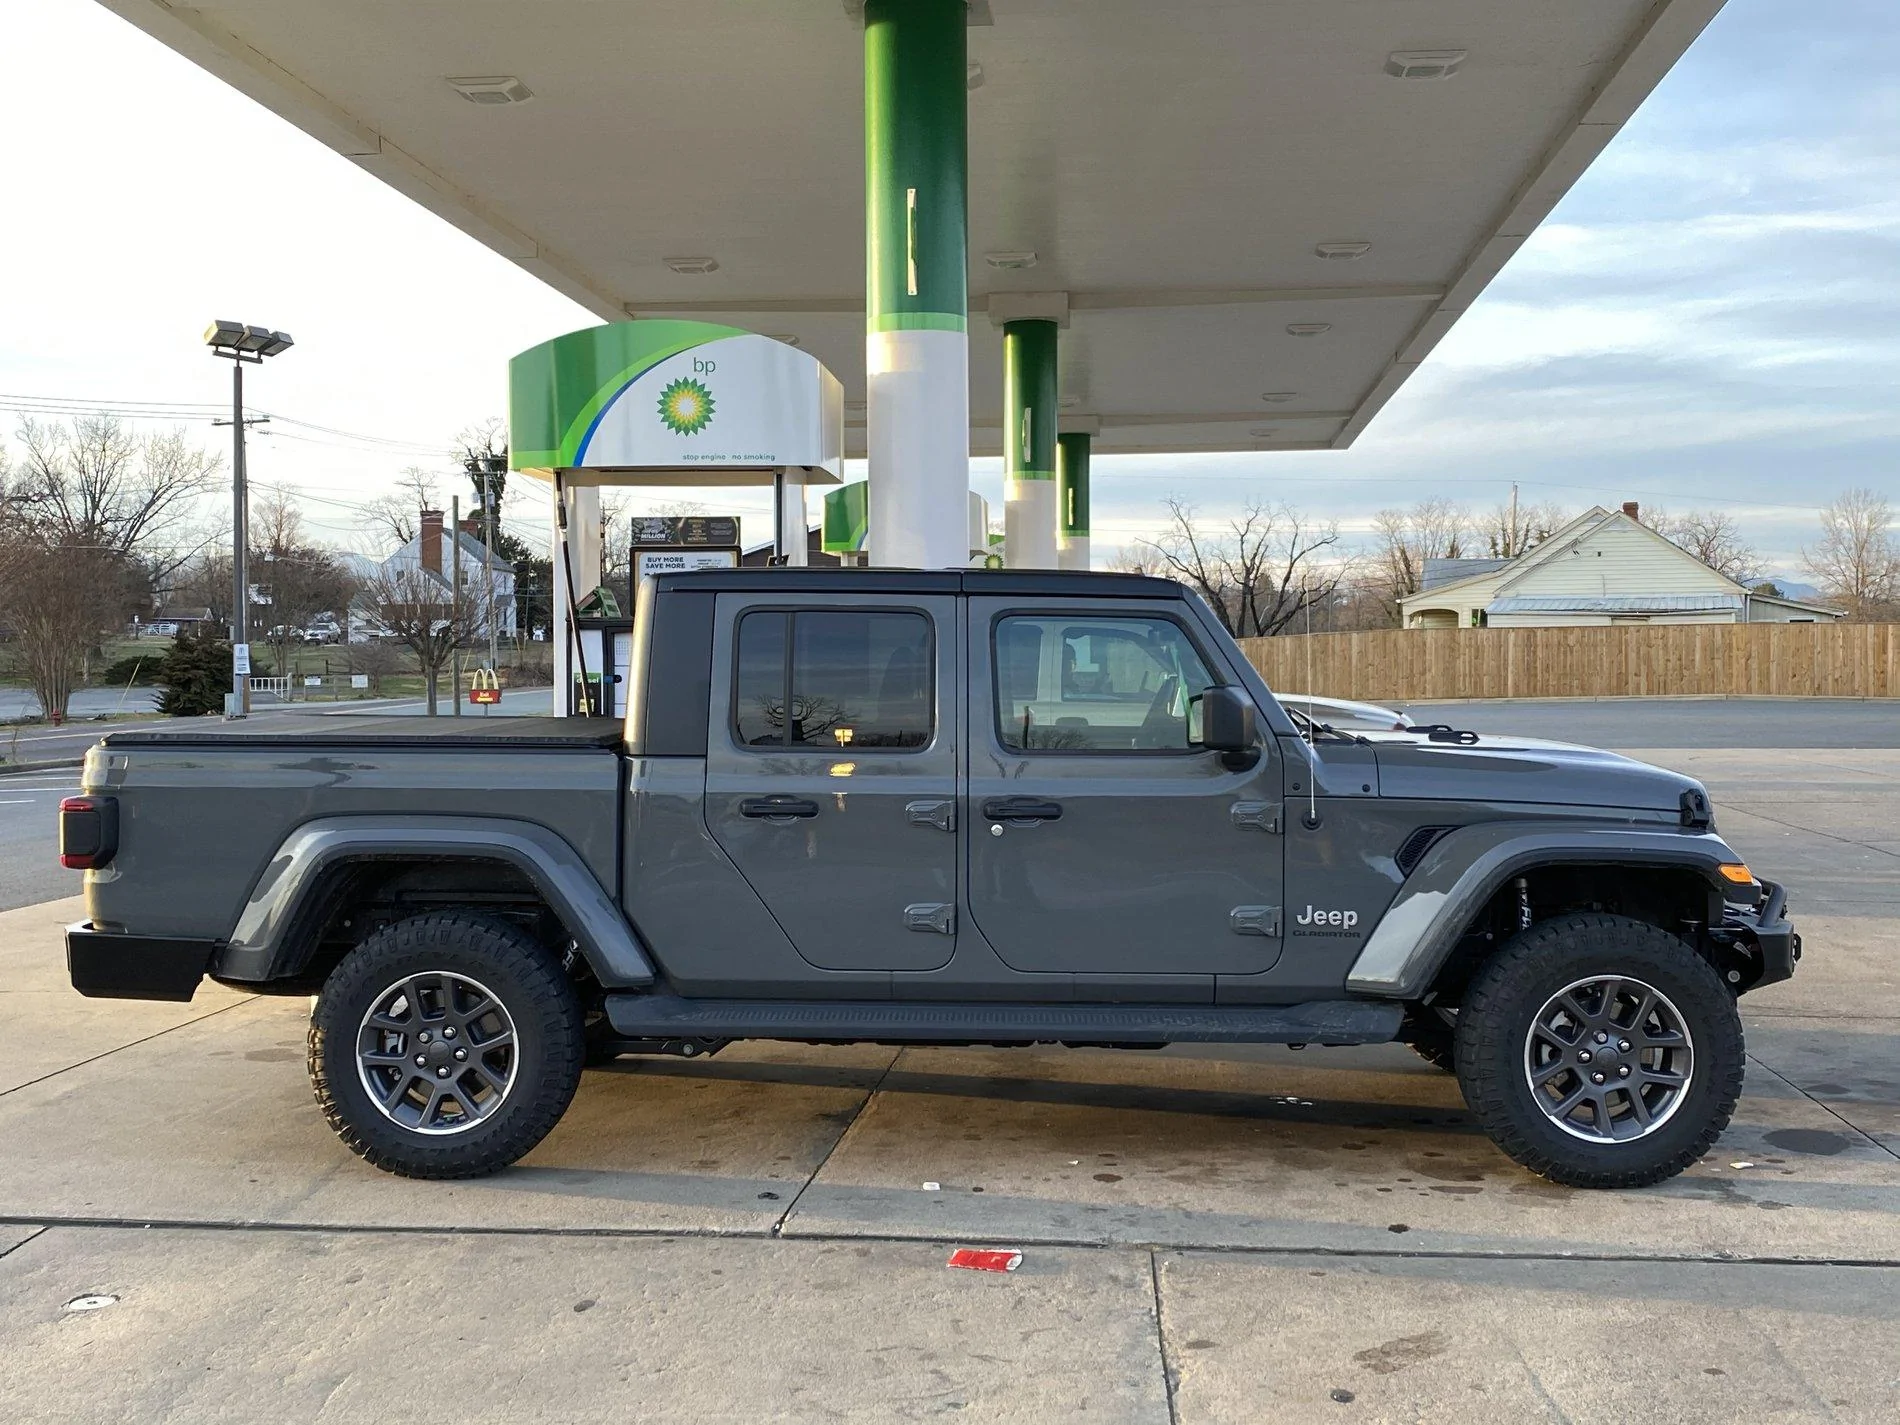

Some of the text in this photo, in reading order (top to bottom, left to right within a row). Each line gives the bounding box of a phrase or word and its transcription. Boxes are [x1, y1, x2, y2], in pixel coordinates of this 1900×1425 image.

[693, 356, 716, 376] bp
[682, 453, 699, 461] stop
[701, 453, 726, 461] engine
[744, 453, 775, 461] smoking
[1296, 905, 1358, 929] Jeep
[1293, 930, 1360, 938] GLADIATOR
